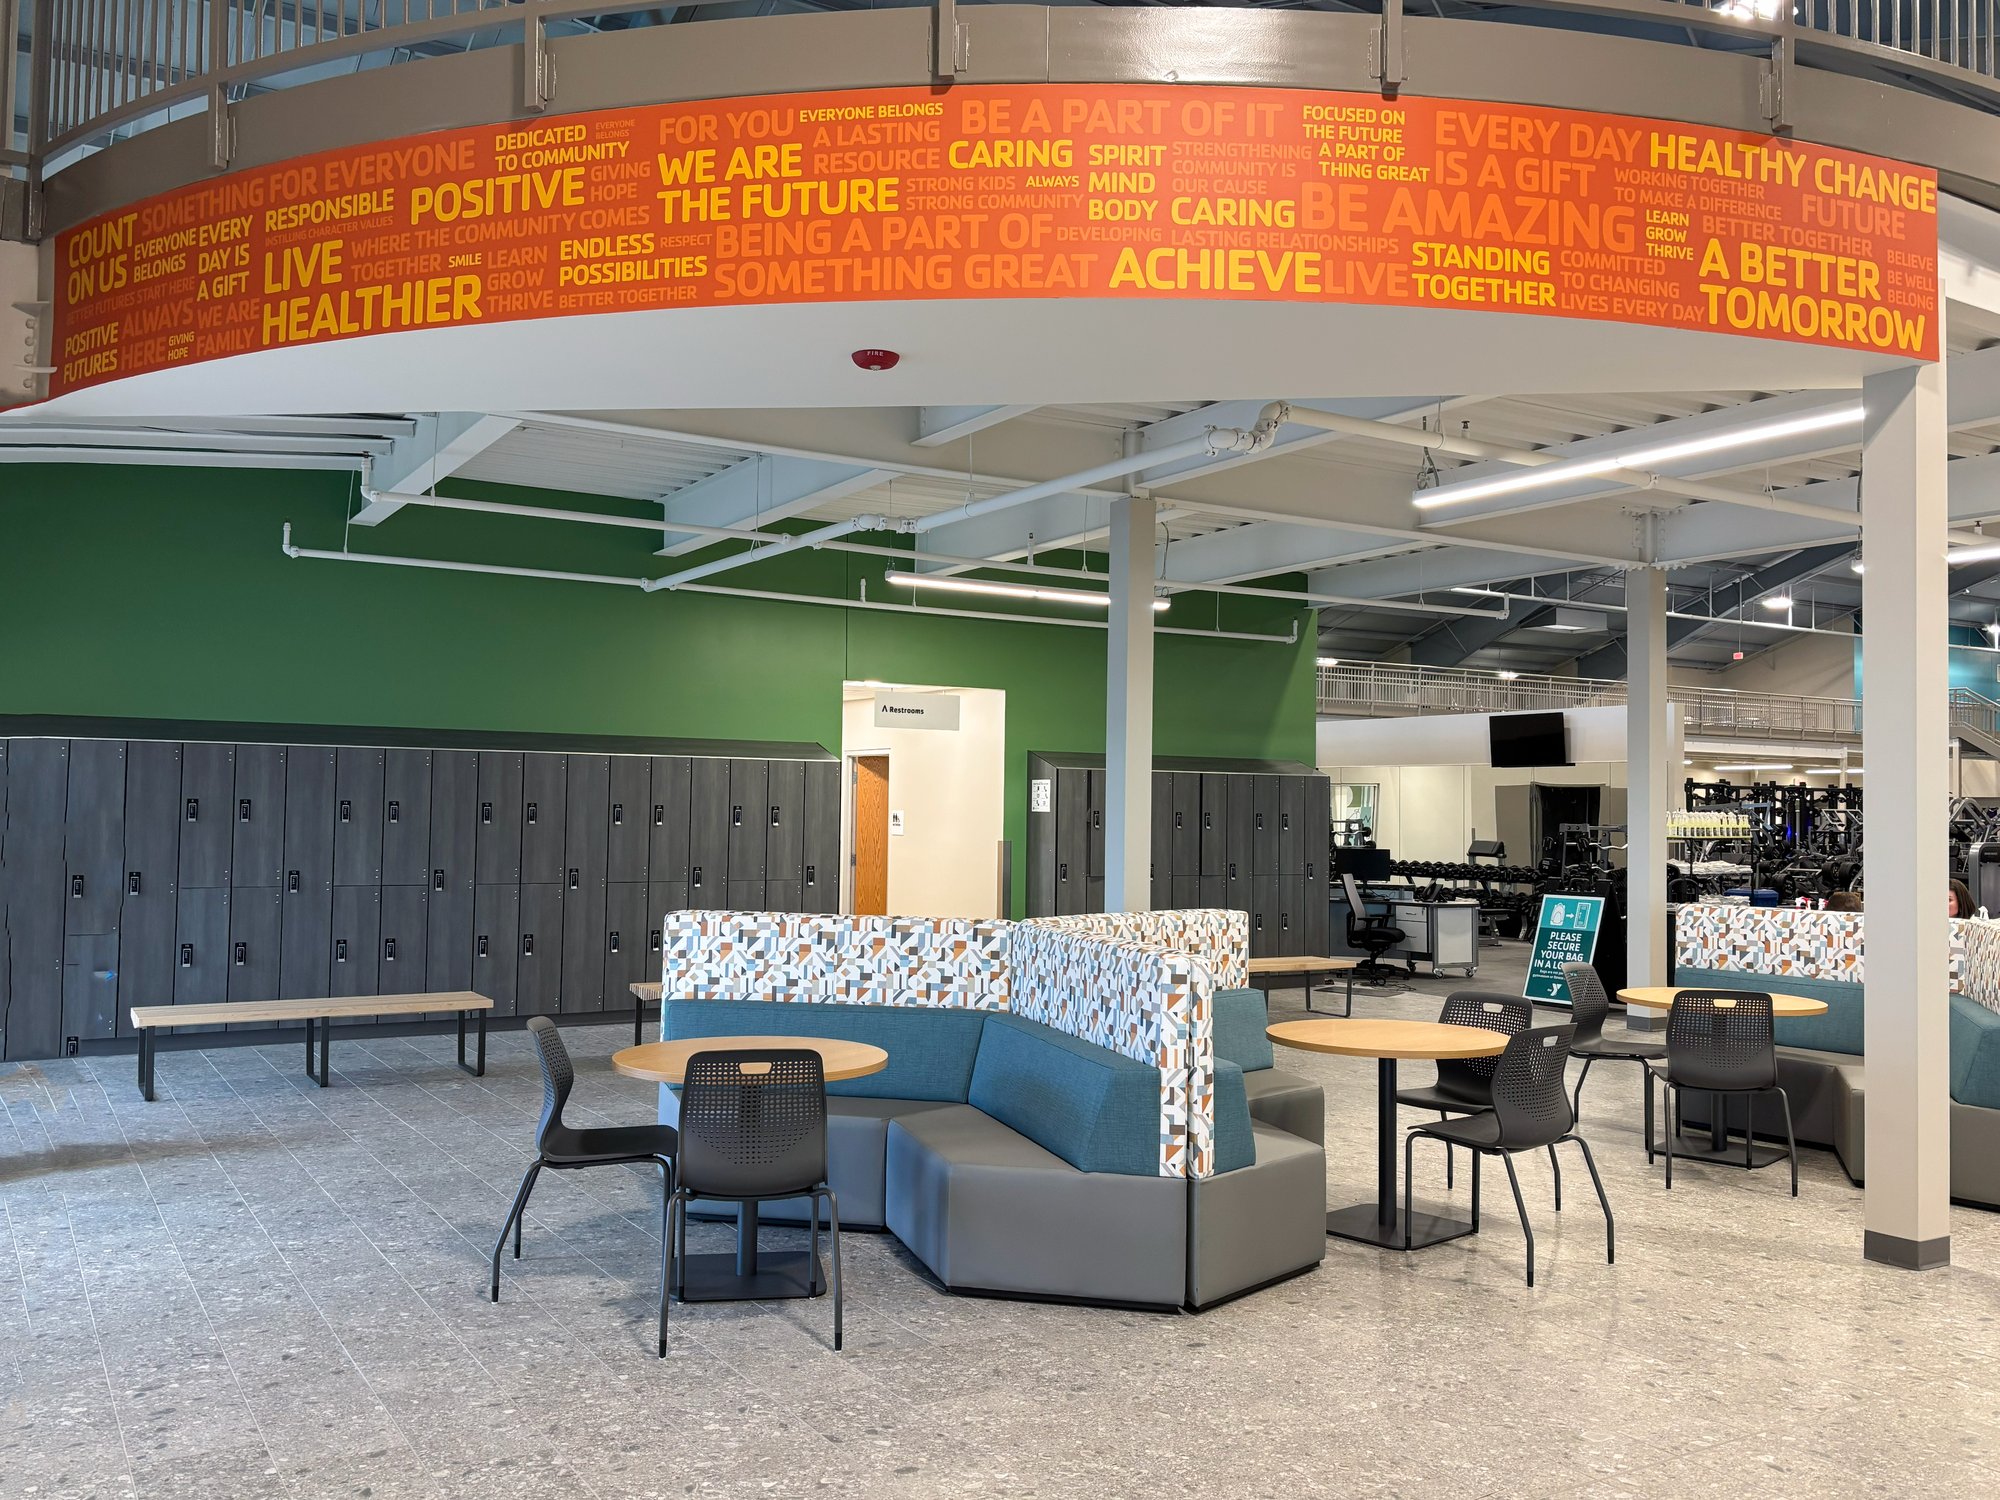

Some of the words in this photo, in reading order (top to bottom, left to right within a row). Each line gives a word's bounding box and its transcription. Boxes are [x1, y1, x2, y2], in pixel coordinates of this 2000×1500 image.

[596, 119, 635, 130] EVERYONE
[660, 114, 718, 145] FOR
[727, 109, 794, 139] YOU
[800, 106, 874, 122] EVERYONE
[878, 103, 943, 118] BELONGS
[962, 100, 1011, 134] BE
[1020, 98, 1052, 133] A
[1062, 98, 1171, 134] PART
[1181, 100, 1235, 136] OF
[1246, 102, 1284, 137] IT
[1303, 105, 1376, 124] FOCUSED
[1381, 110, 1405, 125] ON
[495, 124, 586, 151] DEDICATED
[596, 129, 630, 140] BELONGS
[813, 127, 831, 148] A
[837, 120, 940, 146] LASTING
[1303, 124, 1334, 140] THE
[1339, 125, 1402, 143] FUTURE
[1436, 110, 1560, 154] EVERY
[1570, 123, 1642, 162] DAY
[495, 156, 517, 172] TO
[522, 141, 630, 168] COMMUNITY
[657, 149, 716, 185] WE
[724, 143, 802, 181] ARE
[814, 148, 940, 174] RESOURCE
[949, 139, 1073, 169] CARING
[1088, 144, 1167, 167] SPIRIT
[1172, 141, 1312, 160] STRENGTHENING
[1318, 143, 1331, 157] A
[1336, 144, 1379, 160] PART
[1383, 146, 1405, 162] OF
[590, 161, 650, 182] GIVING
[1026, 176, 1079, 188] ALWAYS
[1088, 172, 1156, 193] MIND
[1172, 160, 1278, 177] COMMUNITY
[1282, 164, 1296, 177] IS
[1318, 161, 1372, 179] THING
[1377, 165, 1430, 182] GREAT
[1435, 150, 1468, 186] IS
[1477, 154, 1506, 189] A
[1515, 157, 1596, 197] GIFT
[1650, 132, 1806, 187] HEALTHY
[1814, 158, 1936, 214] CHANGE
[142, 178, 264, 236] SOMETHING
[270, 166, 317, 202] FOR
[325, 139, 475, 191] EVERYONE
[411, 167, 585, 225] POSITIVE
[590, 183, 637, 202] HOPE
[906, 176, 973, 192] STRONG
[979, 176, 1015, 190] KIDS
[1172, 178, 1208, 193] OUR
[1213, 179, 1267, 195] CAUSE
[1614, 168, 1687, 189] WORKING
[1690, 176, 1765, 200] TOGETHER
[265, 188, 394, 232] RESPONSIBLE
[656, 186, 731, 224] THE
[743, 177, 899, 218] FUTURE
[906, 195, 973, 210] STRONG
[978, 194, 1084, 209] COMMUNITY
[1088, 199, 1158, 221] BODY
[1171, 197, 1295, 228] CARING
[1614, 186, 1635, 203] TO
[1640, 190, 1683, 209] MAKE
[1687, 194, 1696, 211] A
[1700, 196, 1781, 221] DIFFERENCE
[200, 215, 253, 247] EVERY
[1302, 181, 1368, 232] BE
[1382, 187, 1635, 253] AMAZING
[1646, 209, 1689, 227] LEARN
[1802, 193, 1905, 240] FUTURE
[68, 213, 138, 268] COUNT
[135, 228, 196, 262] EVERYONE
[265, 229, 307, 247] INSTILLING
[308, 223, 358, 240] CHARACTER
[360, 216, 393, 230] VALUES
[351, 233, 410, 259] WHERE
[415, 228, 449, 249] THE
[454, 212, 576, 244] COMMUNITY
[580, 205, 650, 230] COMES
[660, 234, 712, 248] RESPECT
[716, 220, 831, 259] BEING
[841, 218, 872, 252] A
[882, 214, 988, 250] PART
[999, 212, 1053, 249] OF
[1056, 226, 1162, 242] DEVELOPING
[1172, 230, 1250, 247] LASTING
[1256, 232, 1399, 254] RELATIONSHIPS
[1646, 227, 1687, 243] GROW
[1702, 215, 1775, 243] BETTER
[1780, 225, 1872, 257] TOGETHER
[198, 247, 230, 274] DAY
[235, 243, 249, 266] IS
[448, 253, 482, 268] SMILE
[488, 246, 547, 269] LEARN
[560, 233, 654, 260] ENDLESS
[1412, 241, 1550, 276] STANDING
[1646, 243, 1694, 261] THRIVE
[1887, 249, 1933, 272] BELIEVE
[134, 253, 186, 283] BELONGS
[264, 239, 343, 294] LIVE
[351, 253, 441, 282] TOGETHER
[559, 256, 707, 286] POSSIBILITIES
[714, 255, 952, 298] SOMETHING
[964, 254, 1098, 290] GREAT
[1109, 247, 1321, 293] ACHIEVE
[1560, 250, 1666, 276] COMMITTED
[1698, 238, 1730, 280] A
[1740, 242, 1881, 301] BETTER
[67, 265, 94, 304] ON
[100, 254, 127, 292] US
[137, 283, 167, 303] START
[169, 276, 195, 294] HERE
[197, 280, 209, 302] A
[213, 271, 249, 298] GIFT
[487, 268, 544, 291] GROW
[1324, 259, 1408, 297] LIVE
[1412, 273, 1556, 307] TOGETHER
[1560, 271, 1585, 289] TO
[1590, 274, 1679, 299] CHANGING
[1888, 269, 1903, 286] BE
[1904, 272, 1934, 292] WELL
[262, 274, 482, 345] HEALTHIER
[487, 290, 553, 313] THRIVE
[559, 292, 613, 309] BETTER
[618, 285, 697, 304] TOGETHER
[1561, 292, 1609, 313] LIVES
[1613, 299, 1666, 318] EVERY
[1673, 304, 1705, 322] DAY
[1888, 289, 1934, 311] BELONG
[122, 300, 193, 339] ALWAYS
[198, 305, 221, 328] WE
[225, 298, 260, 323] ARE
[1699, 284, 1925, 352] TOMORROW
[65, 322, 118, 358] POSITIVE
[169, 331, 195, 346] GIVING
[196, 327, 254, 358] FAMILY
[63, 349, 118, 384] FUTURES
[121, 336, 167, 371] HERE
[168, 347, 188, 361] HOPE
[889, 706, 924, 715] Restrooms
[1547, 941, 1580, 952] SECURE
[1550, 932, 1582, 942] PLEASE
[1534, 959, 1543, 968] IN
[1541, 950, 1564, 960] YOUR
[1566, 952, 1583, 962] BAG
